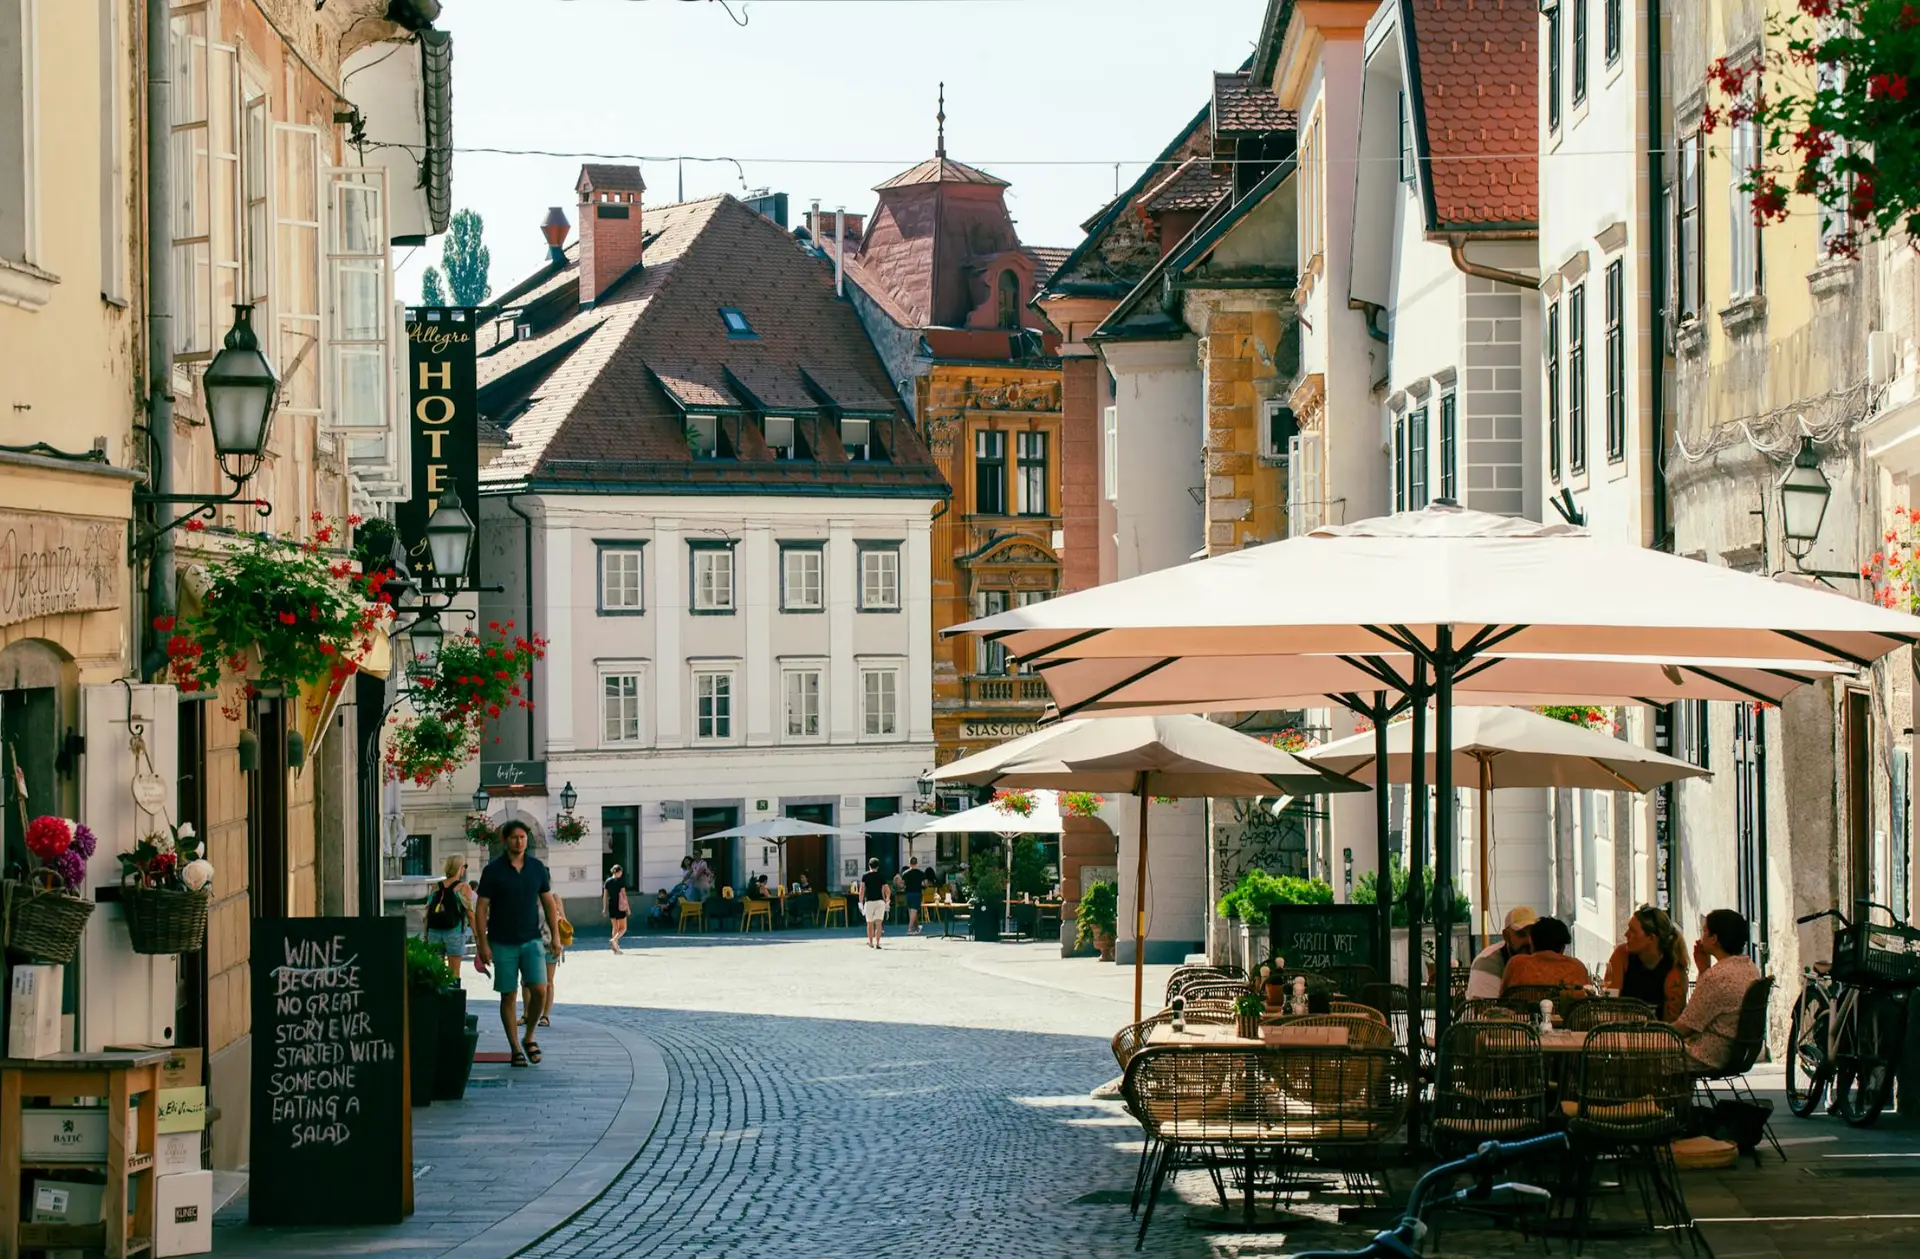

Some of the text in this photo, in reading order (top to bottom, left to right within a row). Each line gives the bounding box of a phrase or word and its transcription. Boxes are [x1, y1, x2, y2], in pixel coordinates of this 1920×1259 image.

[406, 322, 470, 354] Allegro
[17, 592, 77, 617] WINE BOUTIQUE
[284, 935, 346, 967] WINE
[1333, 934, 1358, 953] VRT
[273, 966, 361, 995] BECAUSE
[276, 990, 364, 1019] NO GREAT
[275, 1012, 372, 1043] STORY EVER
[274, 1039, 395, 1068] STARTED WITH
[267, 1064, 355, 1095] SOMEONE
[272, 1095, 360, 1123] EATING A
[290, 1122, 350, 1149] SALAD
